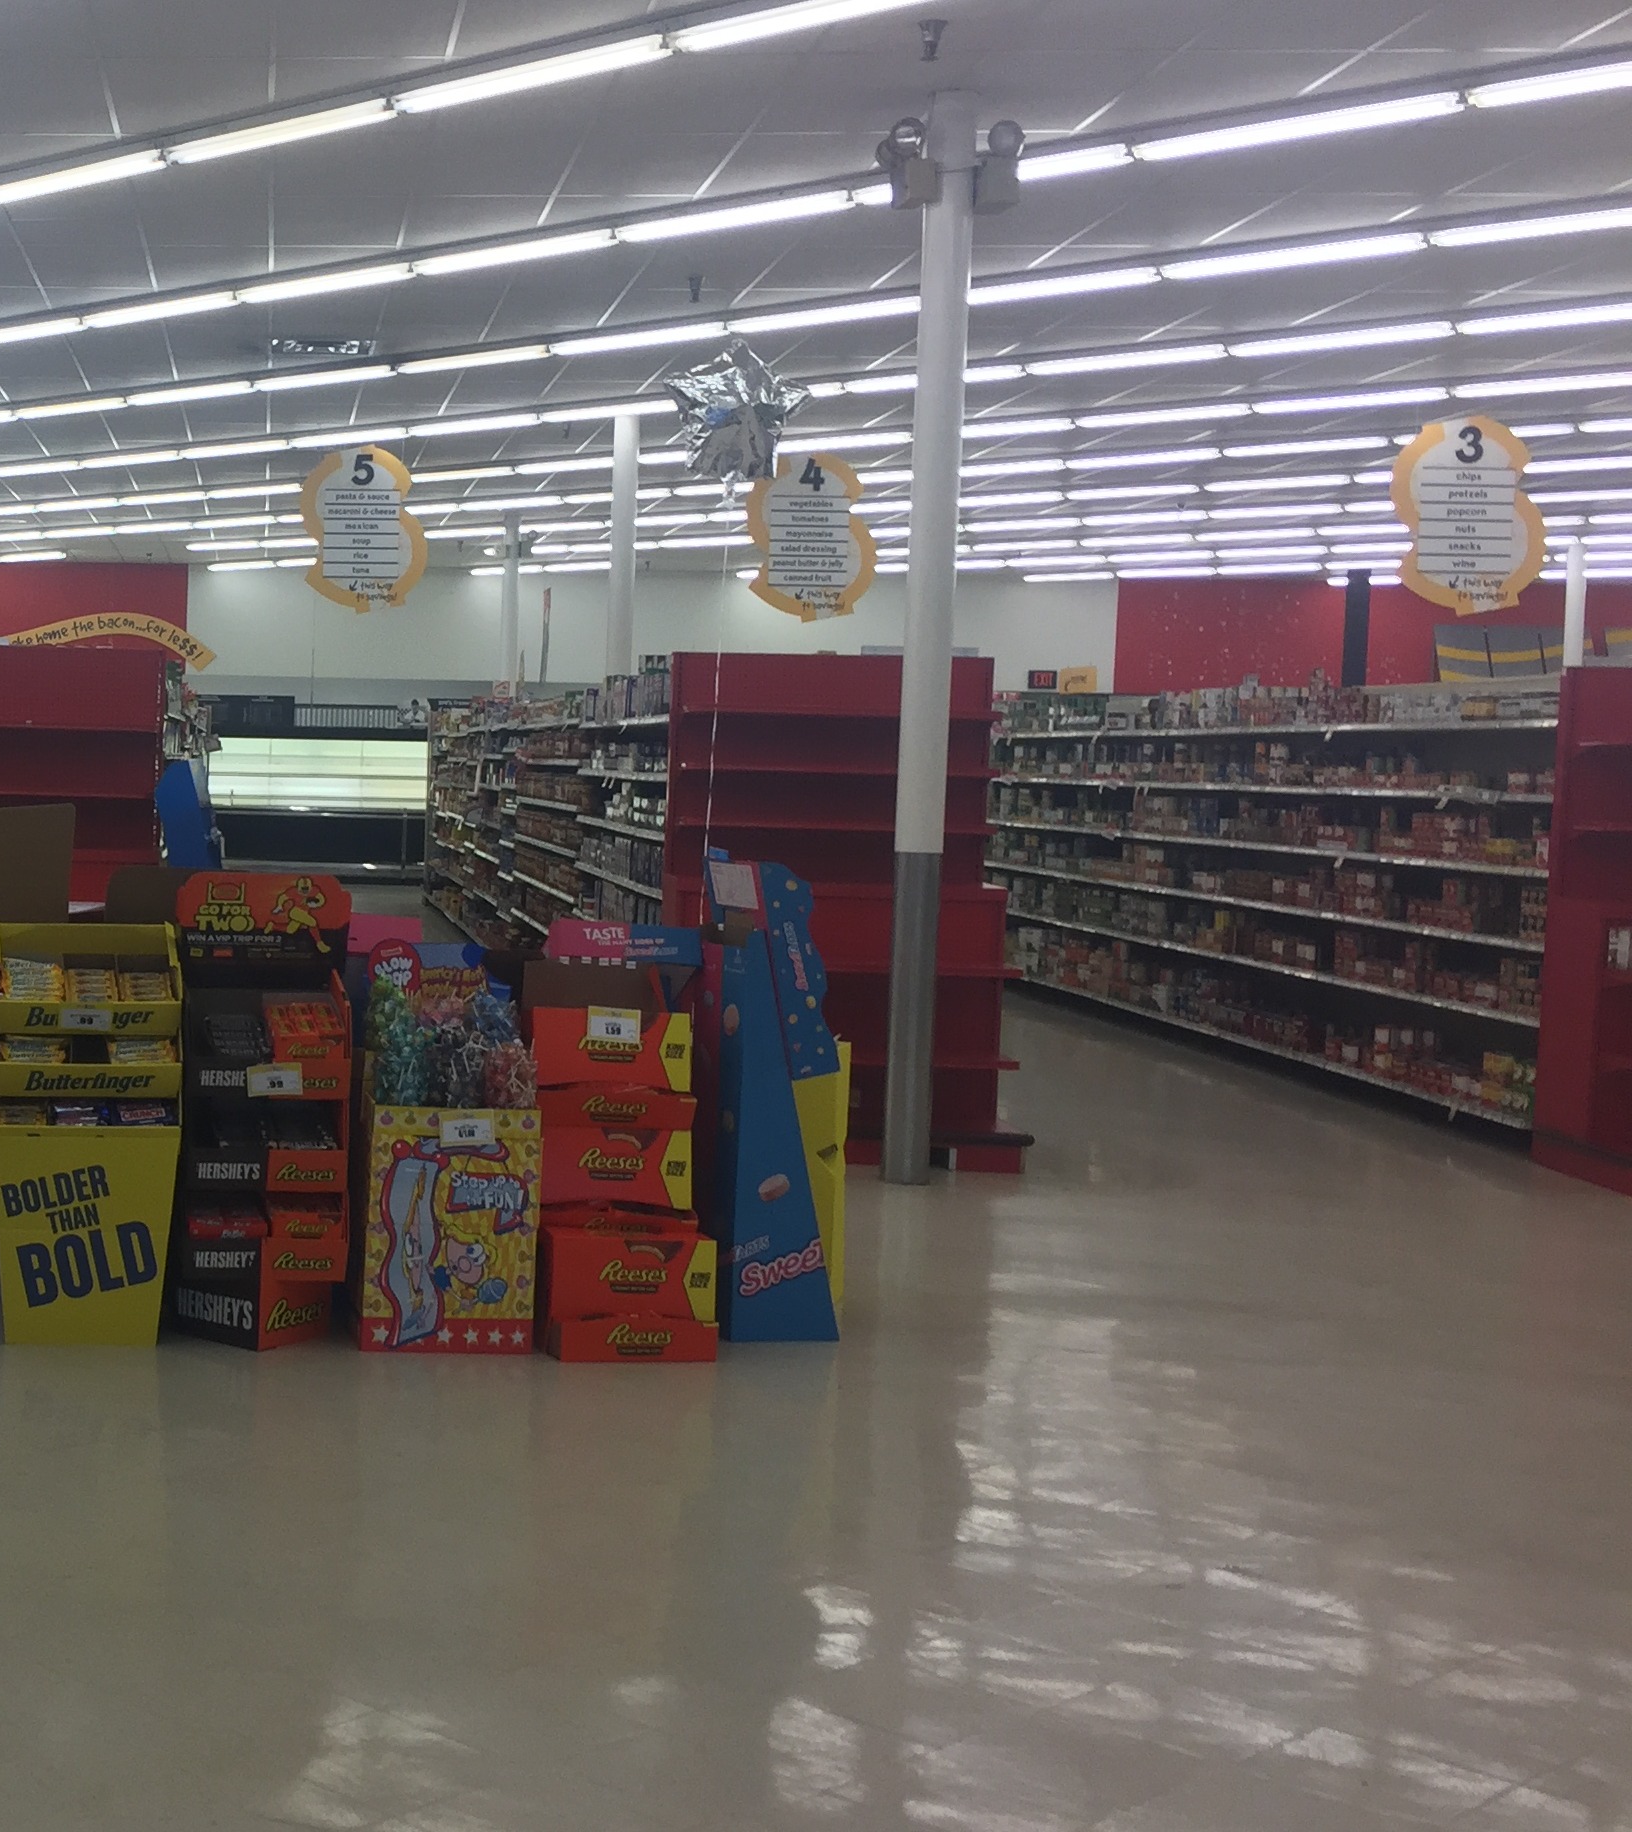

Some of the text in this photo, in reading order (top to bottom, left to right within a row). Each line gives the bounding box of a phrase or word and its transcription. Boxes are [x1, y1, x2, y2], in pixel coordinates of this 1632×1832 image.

[1455, 426, 1484, 464] 3
[351, 454, 375, 486] 5
[799, 457, 825, 492] 4
[1456, 472, 1482, 482] chips
[335, 493, 357, 501] pasta
[1448, 489, 1488, 499] pretzels
[789, 500, 834, 508] vegetables
[791, 515, 829, 523] tomatoes
[1446, 508, 1487, 518] popcorn
[785, 531, 834, 539] mayonnaise
[1454, 525, 1477, 533] nuts
[803, 545, 837, 554] dressing
[1448, 543, 1482, 551] snacks
[772, 560, 797, 568] peanut
[828, 560, 844, 569] jelly
[1452, 560, 1477, 568] wine
[783, 574, 832, 582] canned fruit
[35, 627, 69, 645] home
[71, 620, 94, 638] the
[1034, 672, 1054, 687] EXIT
[198, 904, 252, 916] GO FOR
[195, 914, 256, 933] TWO
[187, 934, 207, 943] WIN
[207, 934, 215, 943] A
[233, 934, 254, 943] TRIP
[255, 934, 274, 943] FOR
[583, 926, 625, 940] TASTE
[24, 1069, 157, 1094] Butterfinger
[266, 1079, 284, 1089] .99
[197, 1162, 261, 1180] HERSHEY'S
[450, 1170, 488, 1193] Step
[0, 1164, 111, 1218] BOLDER
[483, 1188, 524, 1211] FUN!
[45, 1202, 100, 1235] THAN
[16, 1220, 158, 1309] BOLD
[177, 1286, 254, 1331] HERSHEY'S
